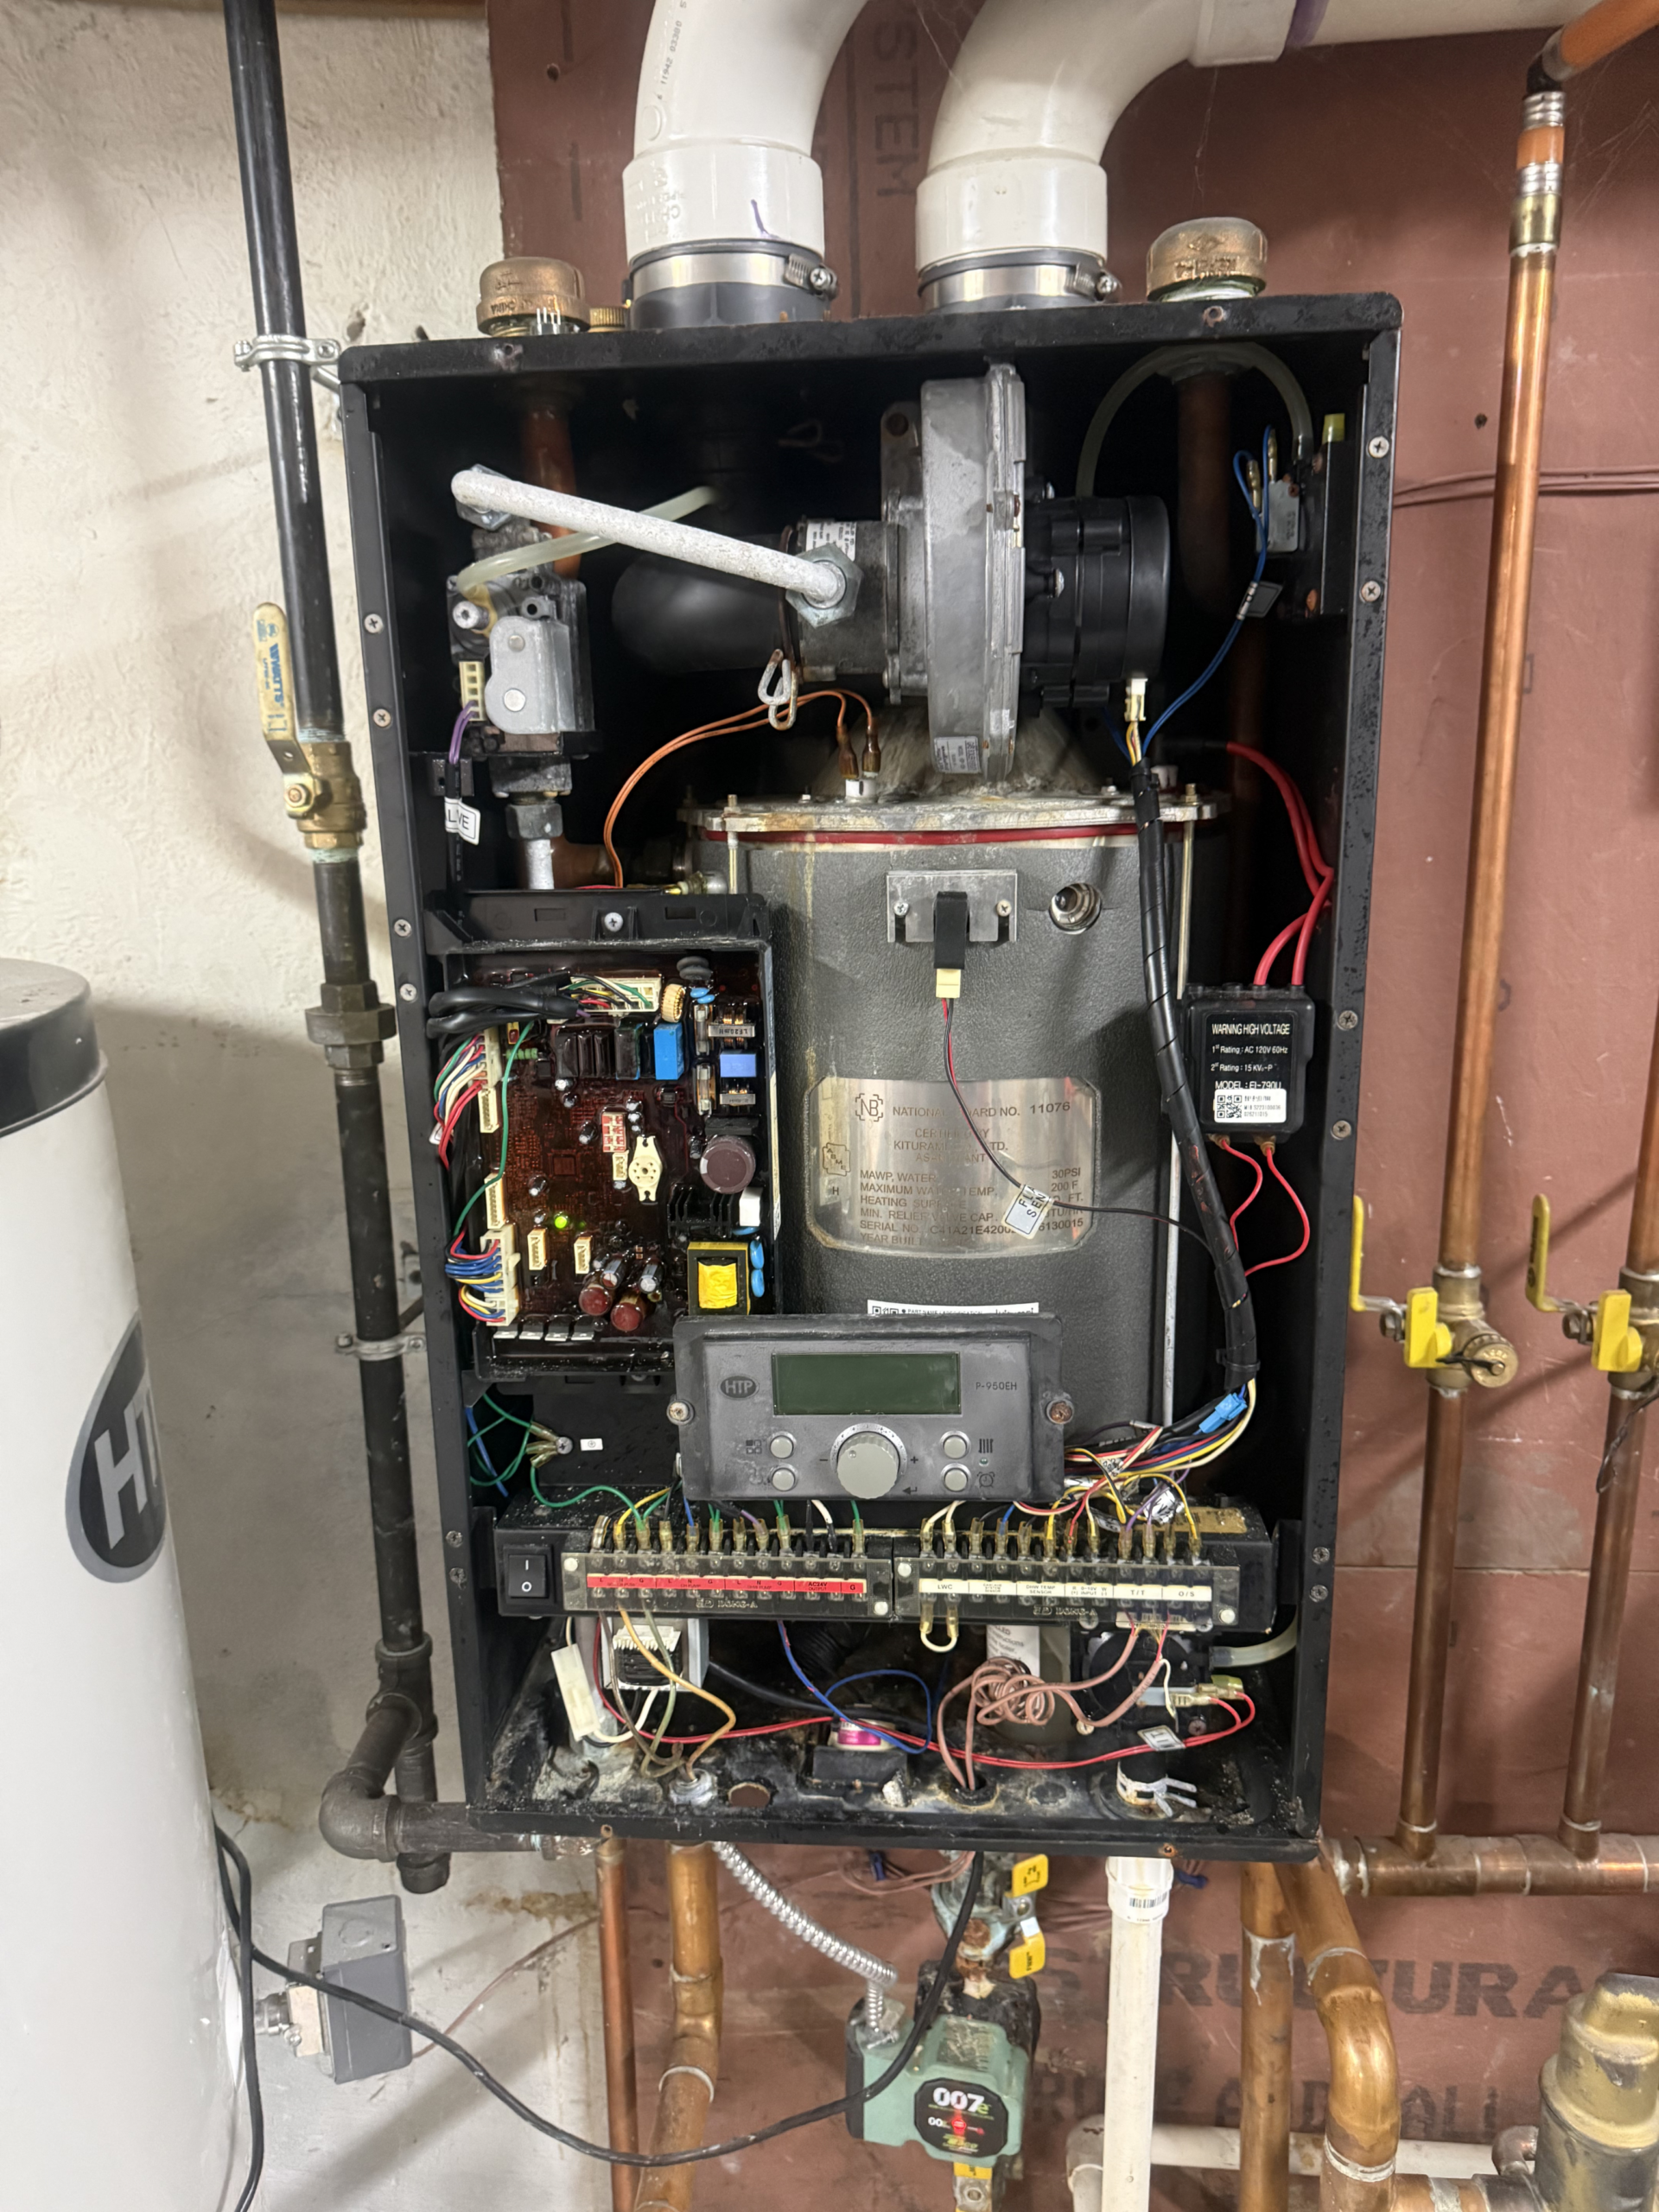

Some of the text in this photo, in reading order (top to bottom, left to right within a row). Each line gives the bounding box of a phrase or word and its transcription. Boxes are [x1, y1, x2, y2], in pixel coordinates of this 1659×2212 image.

[1212, 1023, 1290, 1035] WARNING HIGH VOLTAGE
[1000, 1107, 1020, 1117] NO.
[1030, 1102, 1071, 1115] 11076
[897, 1173, 937, 1183] WATER
[1052, 1167, 1081, 1179] 30PSI
[860, 1182, 912, 1195] MAXIMUM
[1051, 1180, 1079, 1192] 200 F
[860, 1195, 907, 1208] HEATING
[860, 1207, 882, 1219] MIN.
[860, 1220, 898, 1232] SERIAL
[860, 1232, 888, 1243] YEAR
[724, 1379, 753, 1395] HTP
[975, 1381, 1018, 1392] P-950EH
